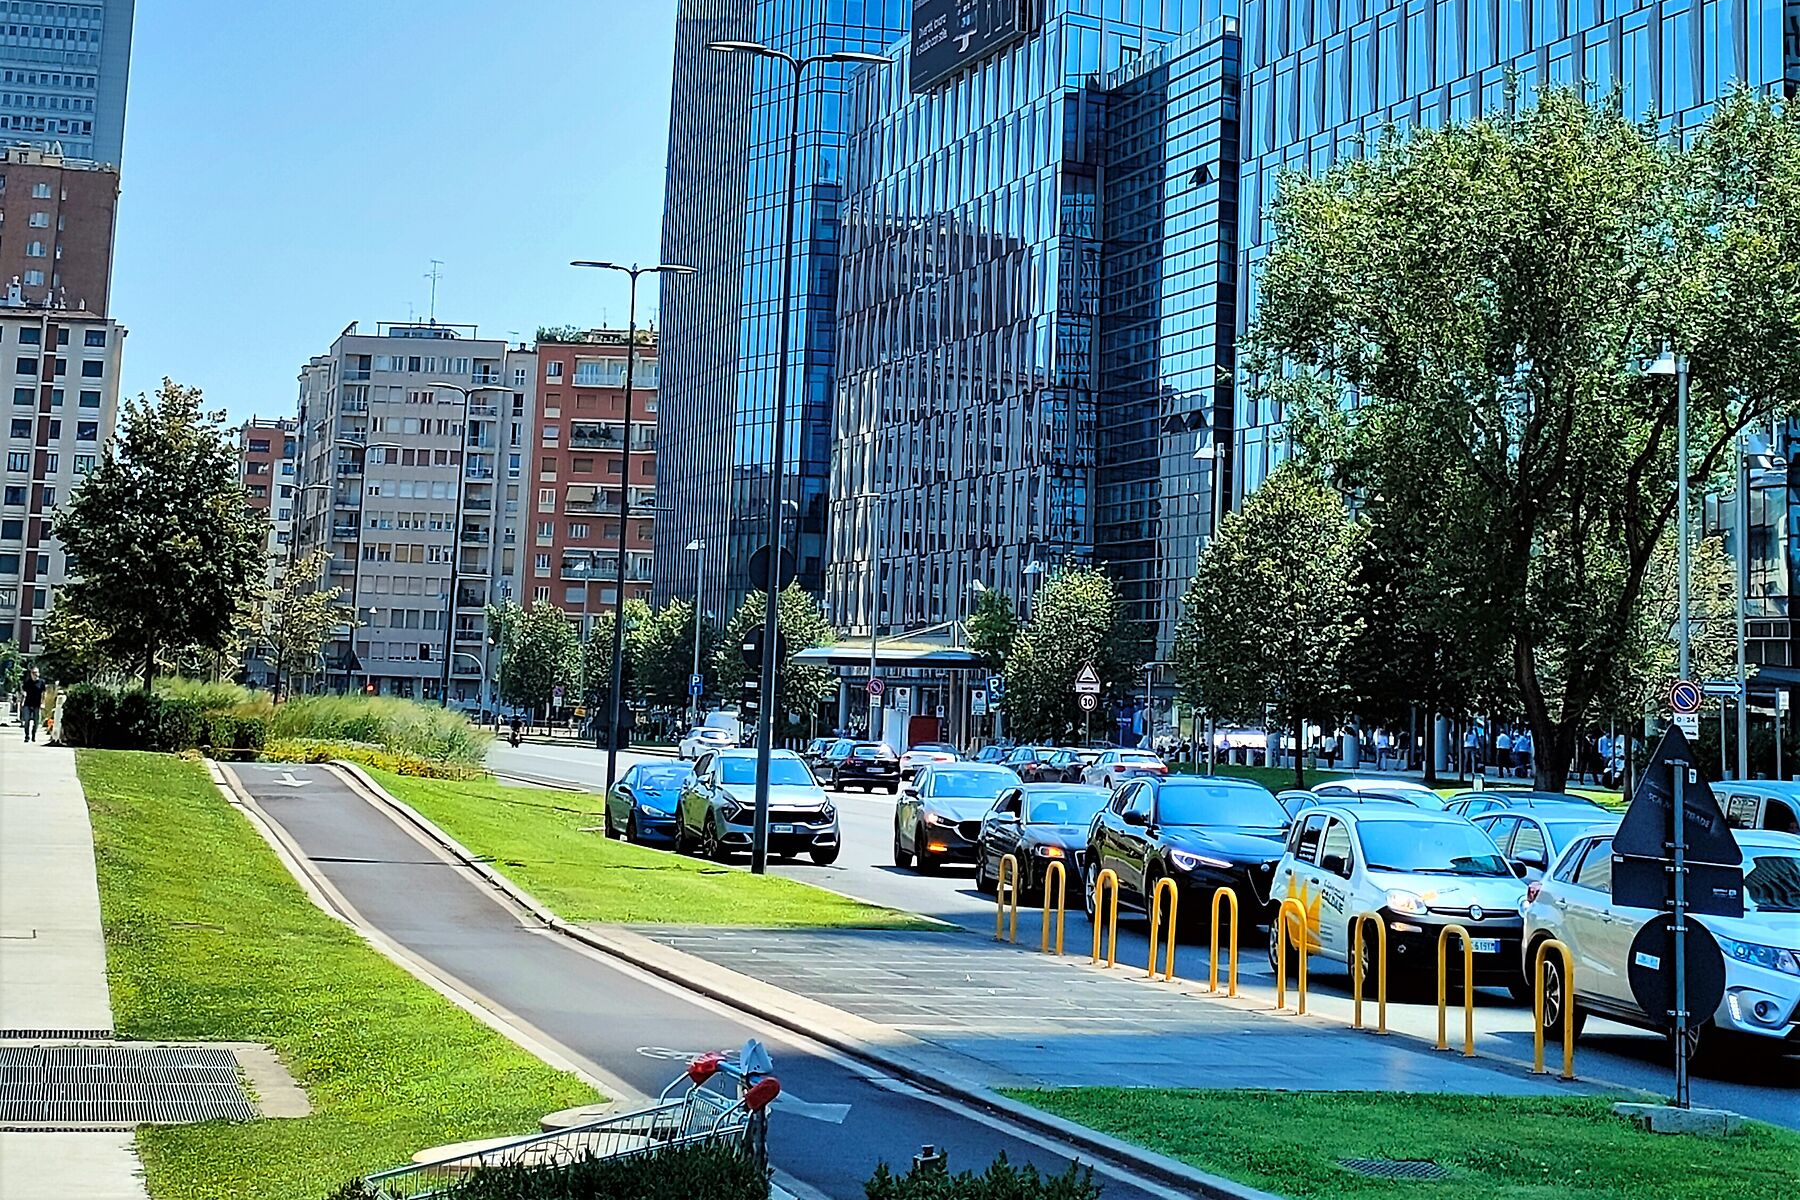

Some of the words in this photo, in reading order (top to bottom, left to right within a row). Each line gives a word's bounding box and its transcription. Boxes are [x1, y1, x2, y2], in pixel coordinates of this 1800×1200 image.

[692, 676, 700, 686] P
[989, 679, 1000, 692] P
[1083, 697, 1093, 707] 30
